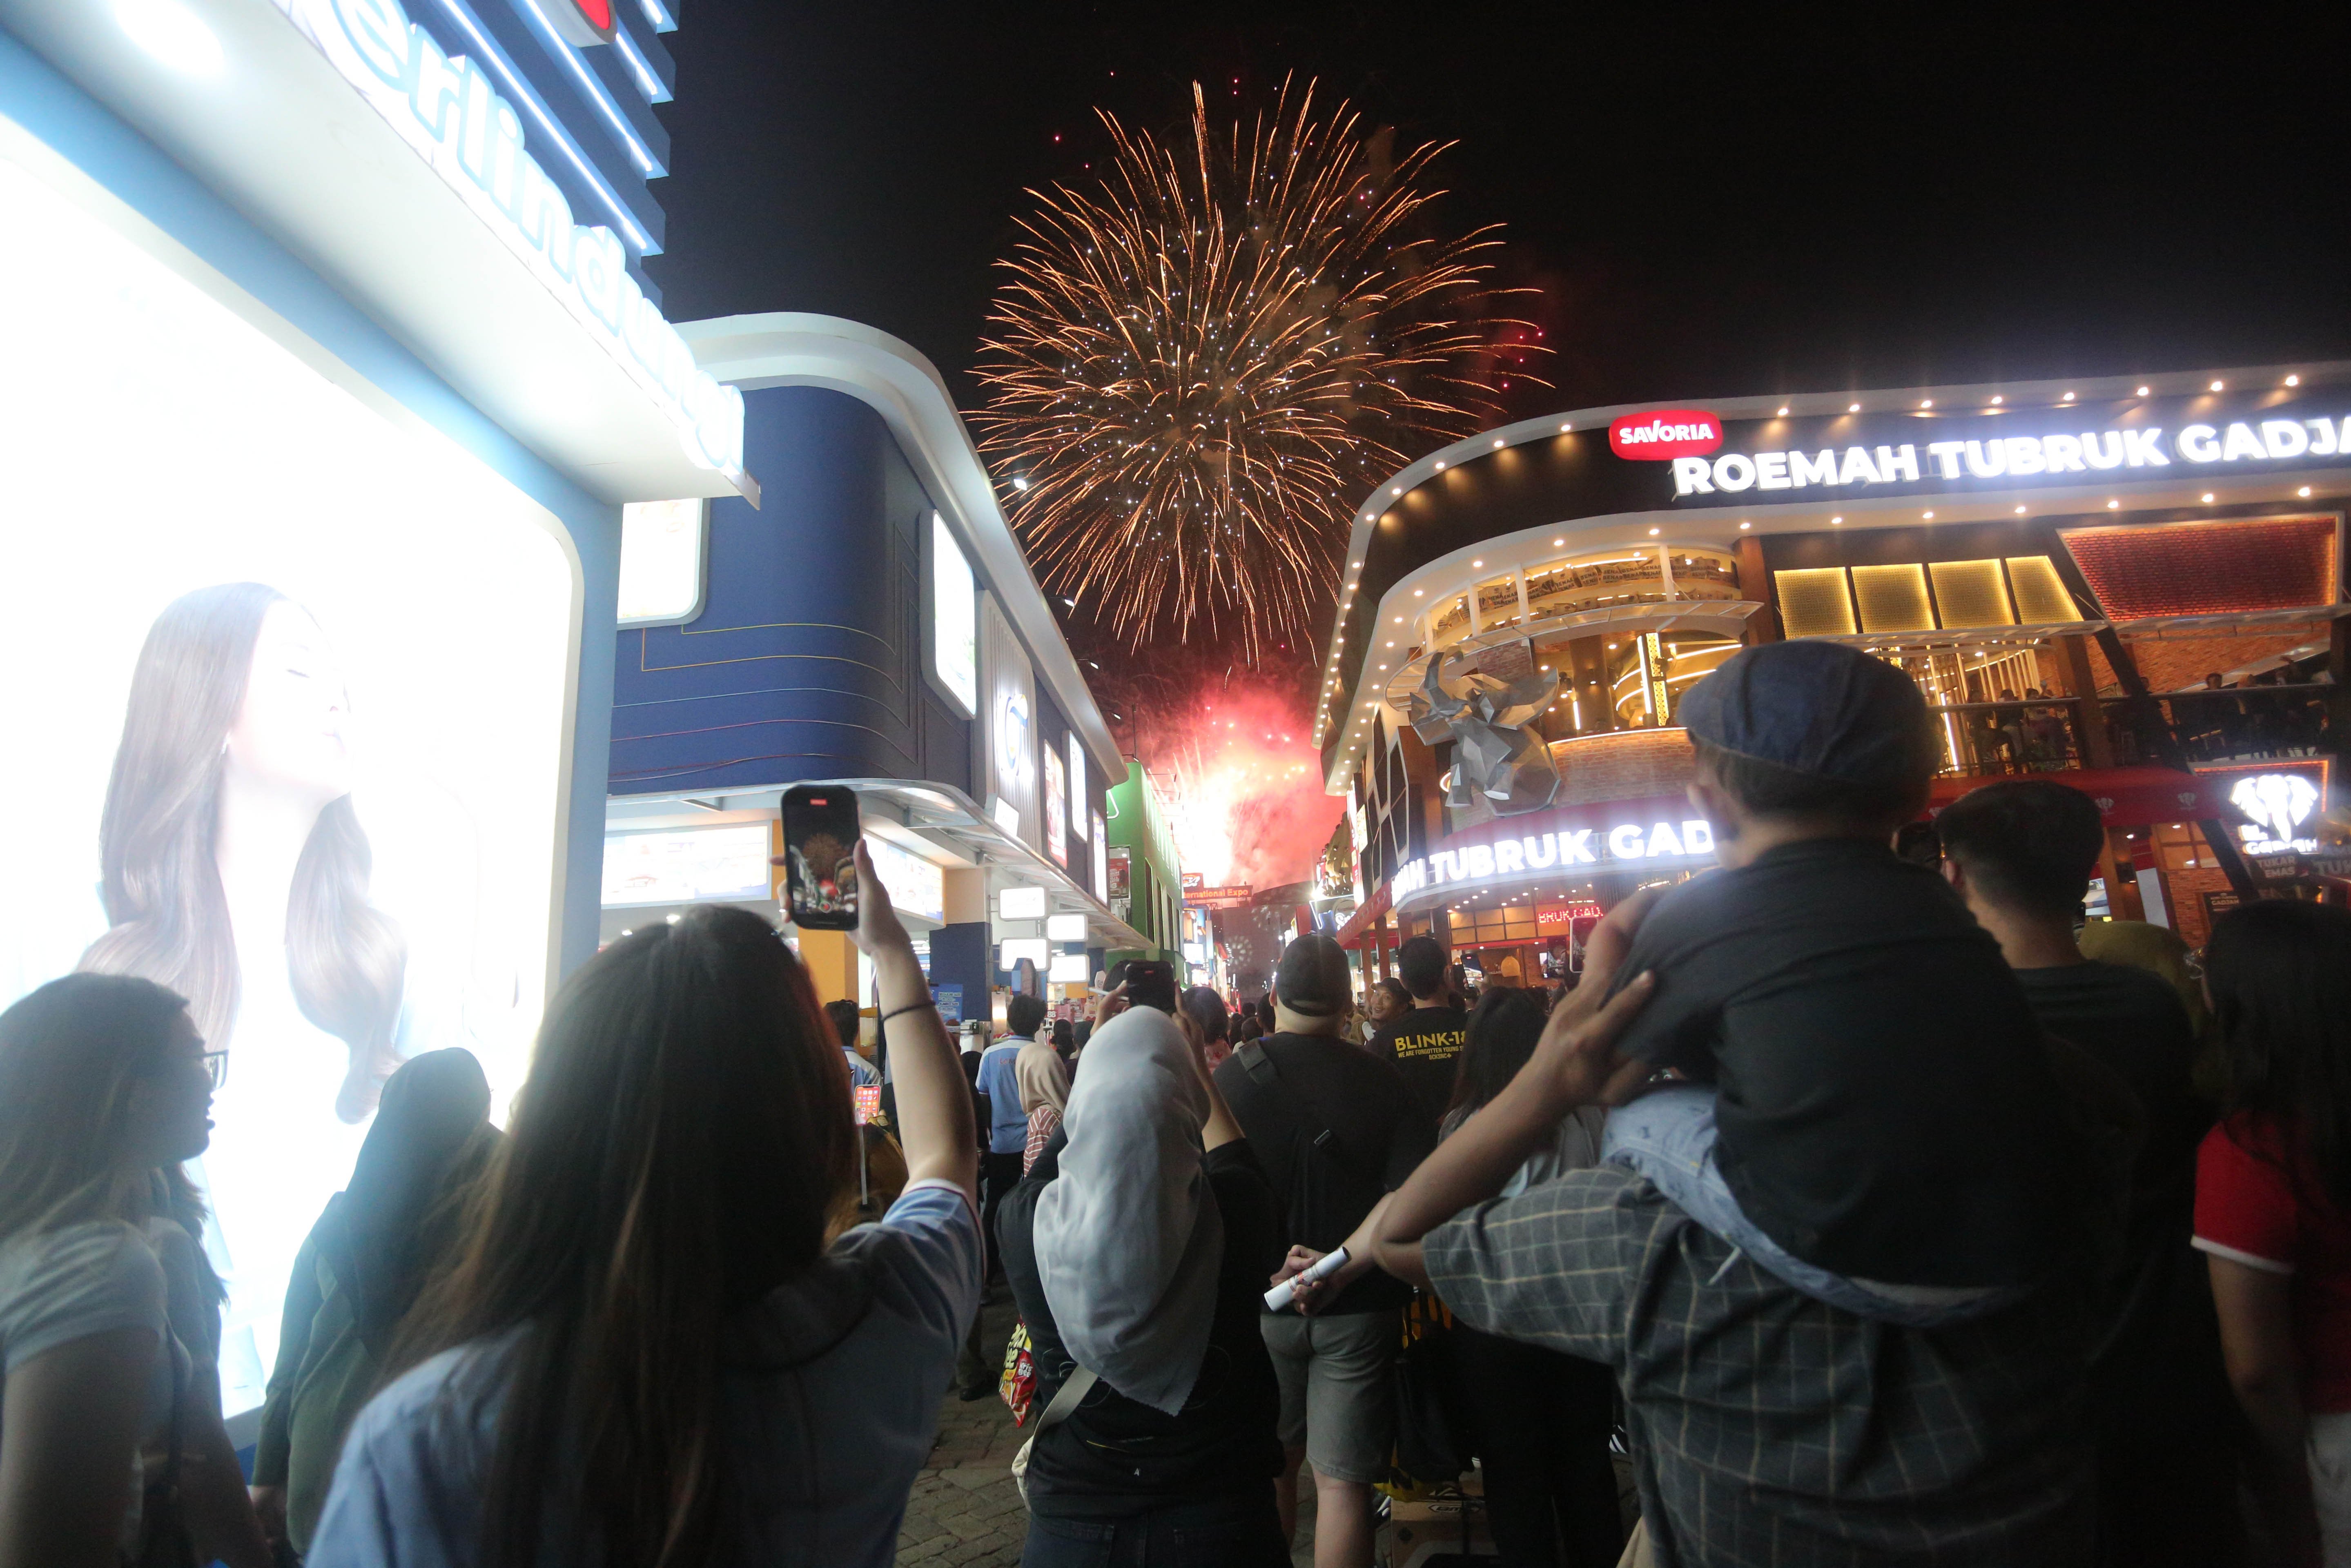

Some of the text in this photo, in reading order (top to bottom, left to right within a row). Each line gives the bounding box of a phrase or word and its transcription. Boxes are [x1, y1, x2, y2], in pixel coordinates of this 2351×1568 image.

[1619, 420, 1714, 444] SAVORIA
[1672, 416, 2351, 495] ROEMAH TUBRUK GADJ
[1429, 829, 1596, 884] TUBRUK
[1609, 820, 1715, 859] GAD
[2256, 856, 2295, 869] TUKAR
[2265, 866, 2296, 878] EMAS
[1227, 889, 1248, 898] Expo
[1538, 905, 1603, 923] BRUK GAD
